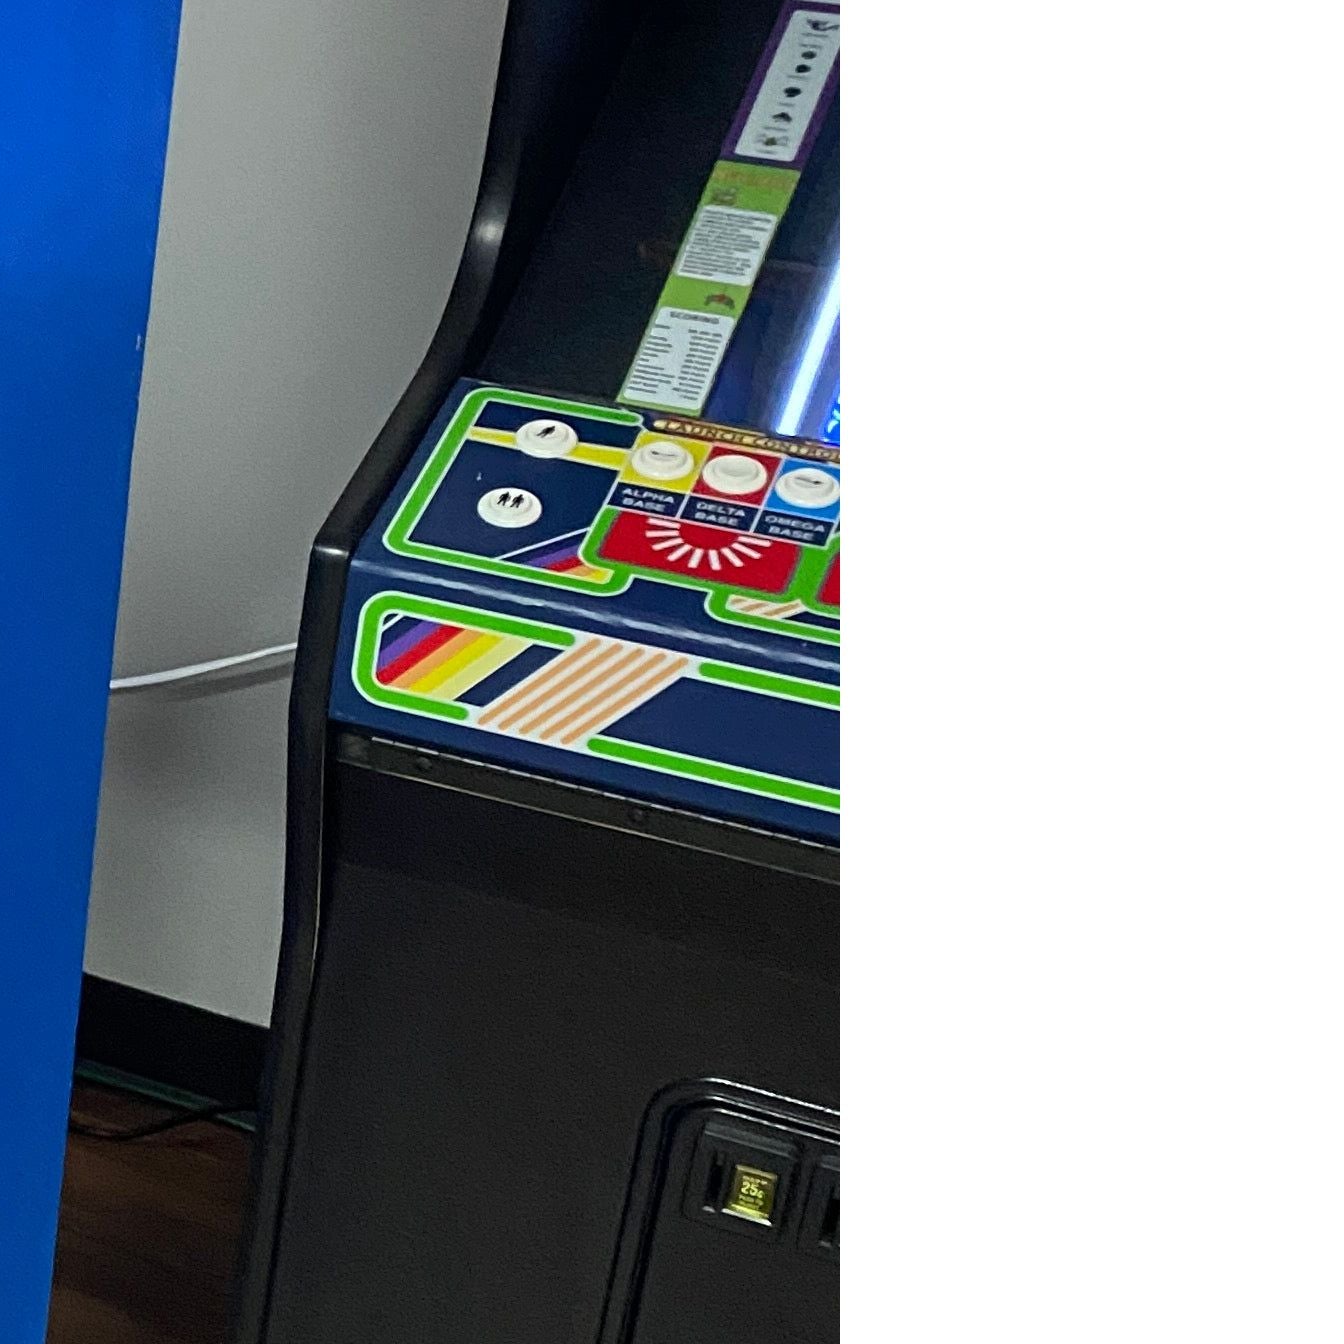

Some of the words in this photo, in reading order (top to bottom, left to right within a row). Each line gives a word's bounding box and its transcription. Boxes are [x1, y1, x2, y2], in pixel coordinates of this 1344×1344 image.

[752, 436, 840, 461] CONTRO
[621, 486, 675, 504] ALPHA
[621, 496, 666, 512] BASE
[696, 501, 746, 517] DELTA
[694, 511, 738, 527] BASE
[764, 514, 826, 533] OMEGA
[768, 524, 813, 540] BASE
